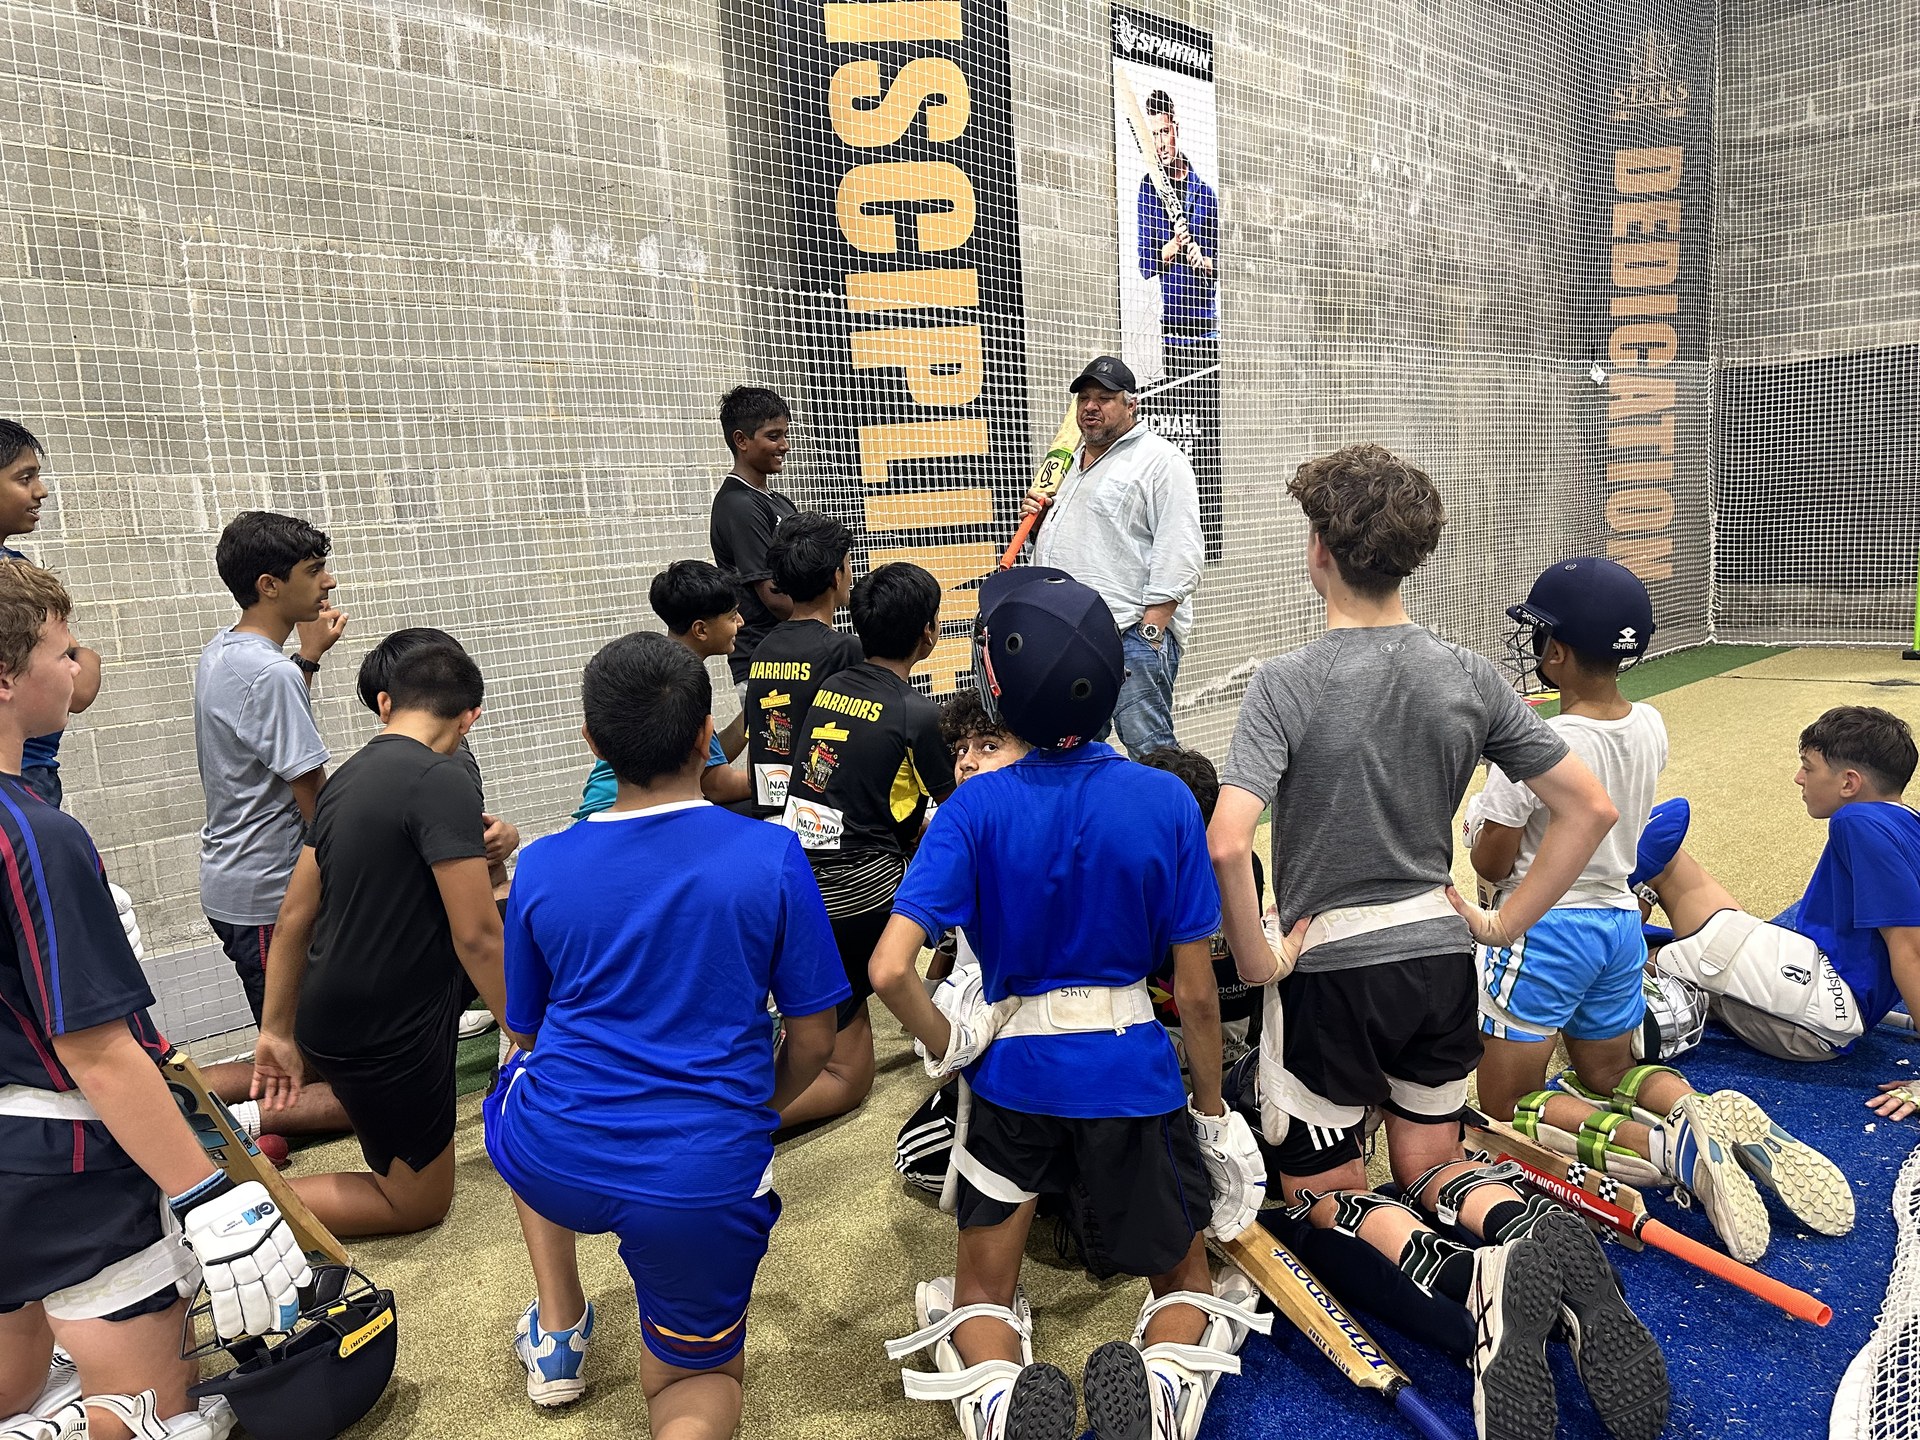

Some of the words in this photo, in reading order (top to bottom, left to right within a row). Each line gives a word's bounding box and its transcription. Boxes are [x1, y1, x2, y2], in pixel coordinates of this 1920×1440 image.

[1137, 31, 1212, 70] SPARTAN
[1605, 146, 1684, 580] DEDICATION
[1612, 642, 1639, 650] SHREY
[1060, 987, 1092, 999] Shiv
[241, 1201, 275, 1226] GM
[350, 1324, 380, 1349] MASURI
[1307, 1327, 1327, 1350] NOBLE
[1327, 1346, 1351, 1375] WILLOW
